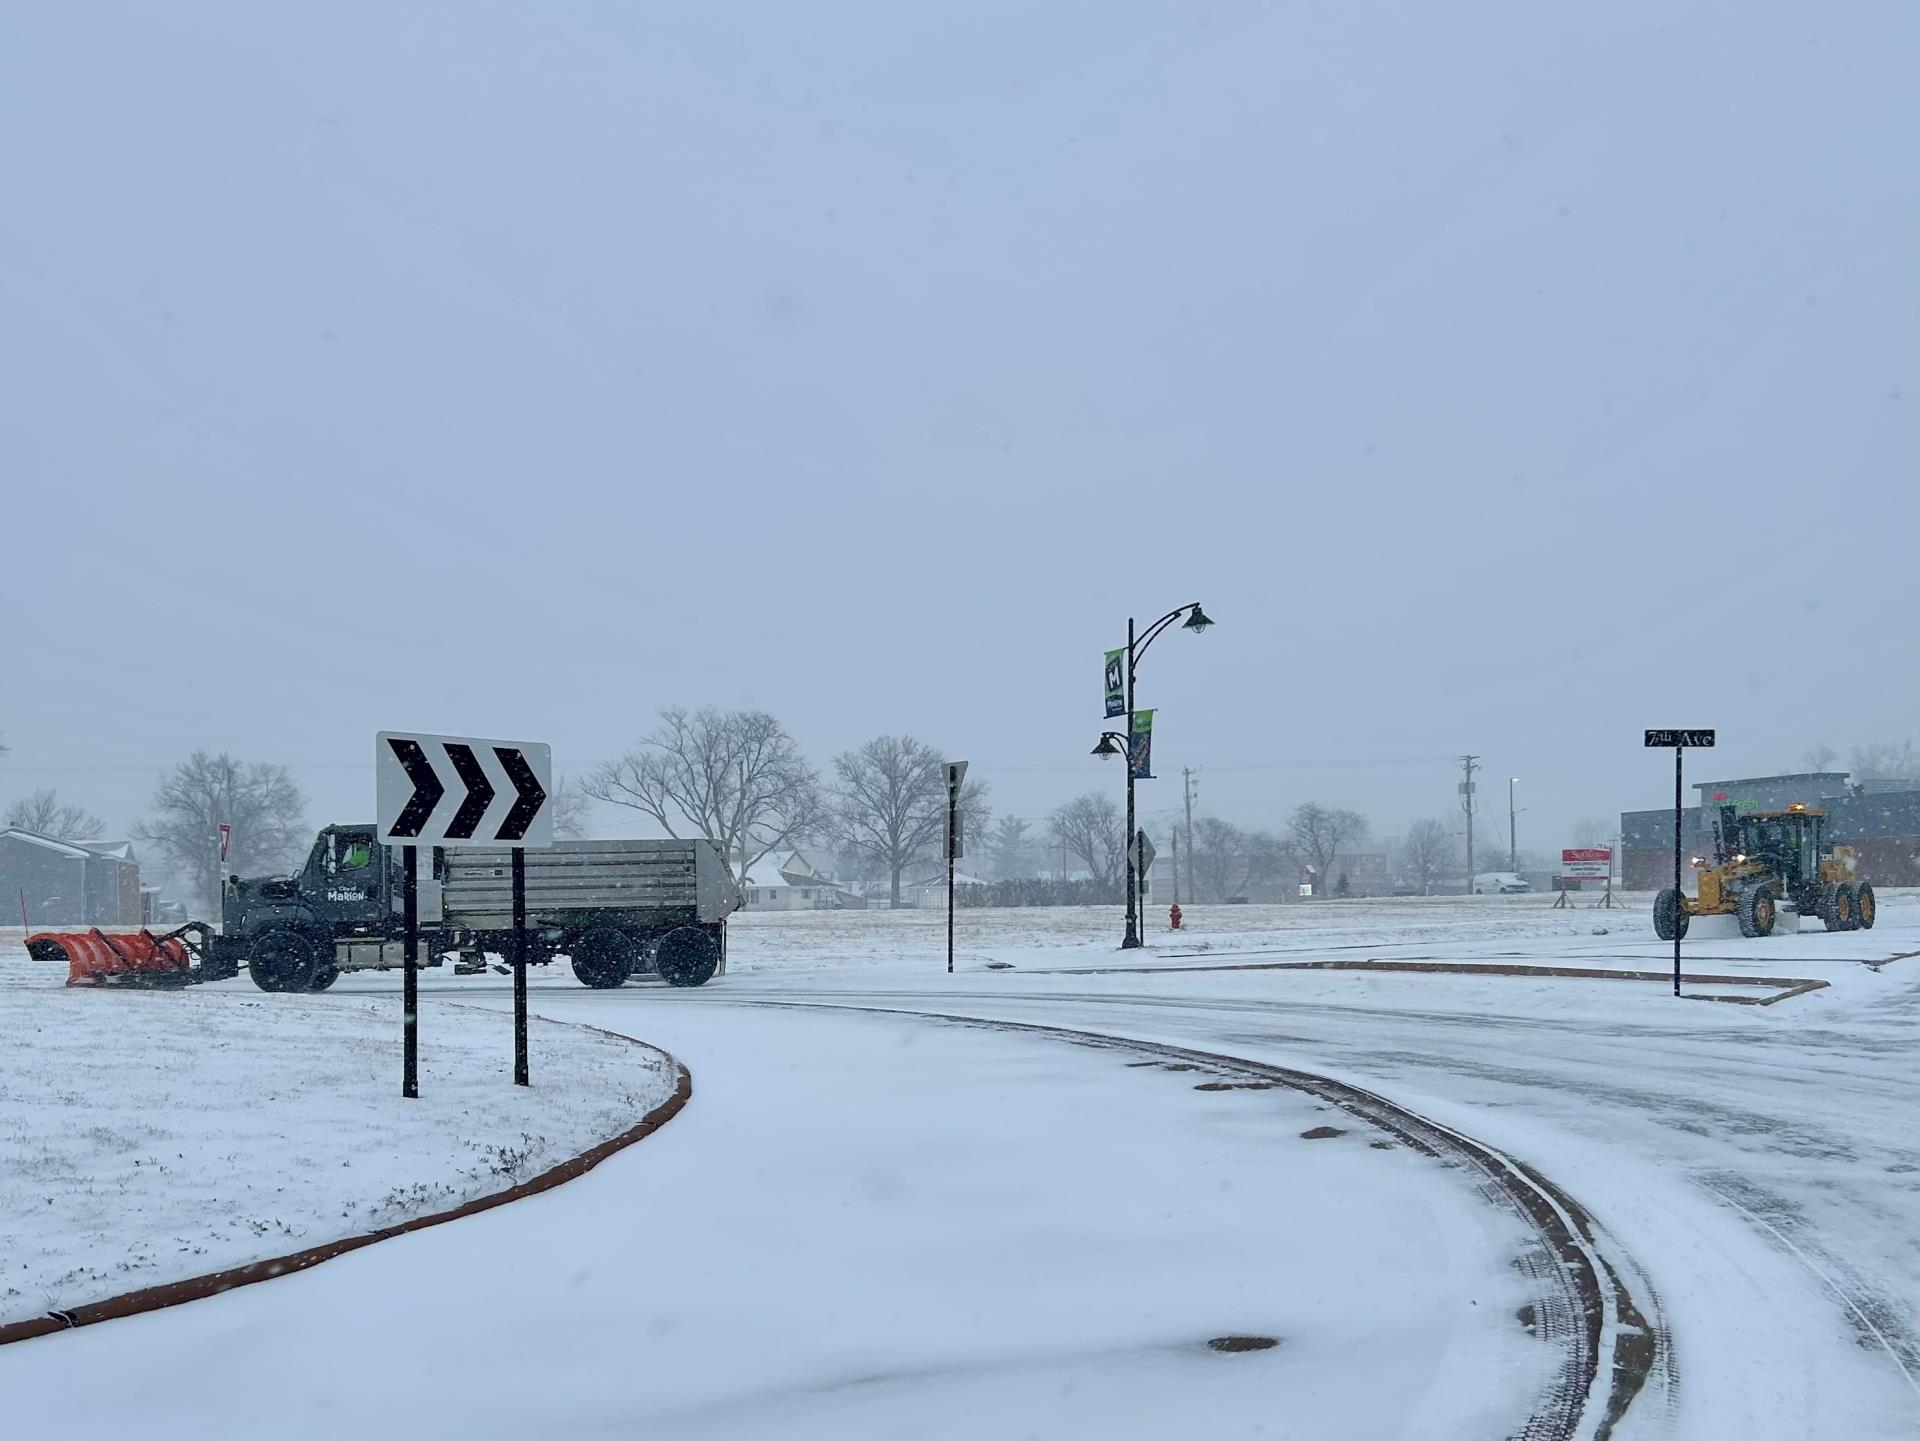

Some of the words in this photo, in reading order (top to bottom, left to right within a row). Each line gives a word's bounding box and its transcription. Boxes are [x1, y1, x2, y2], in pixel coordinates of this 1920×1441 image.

[1108, 665, 1120, 690] M
[1647, 731, 1672, 746] 7th
[1678, 731, 1712, 746] Ave
